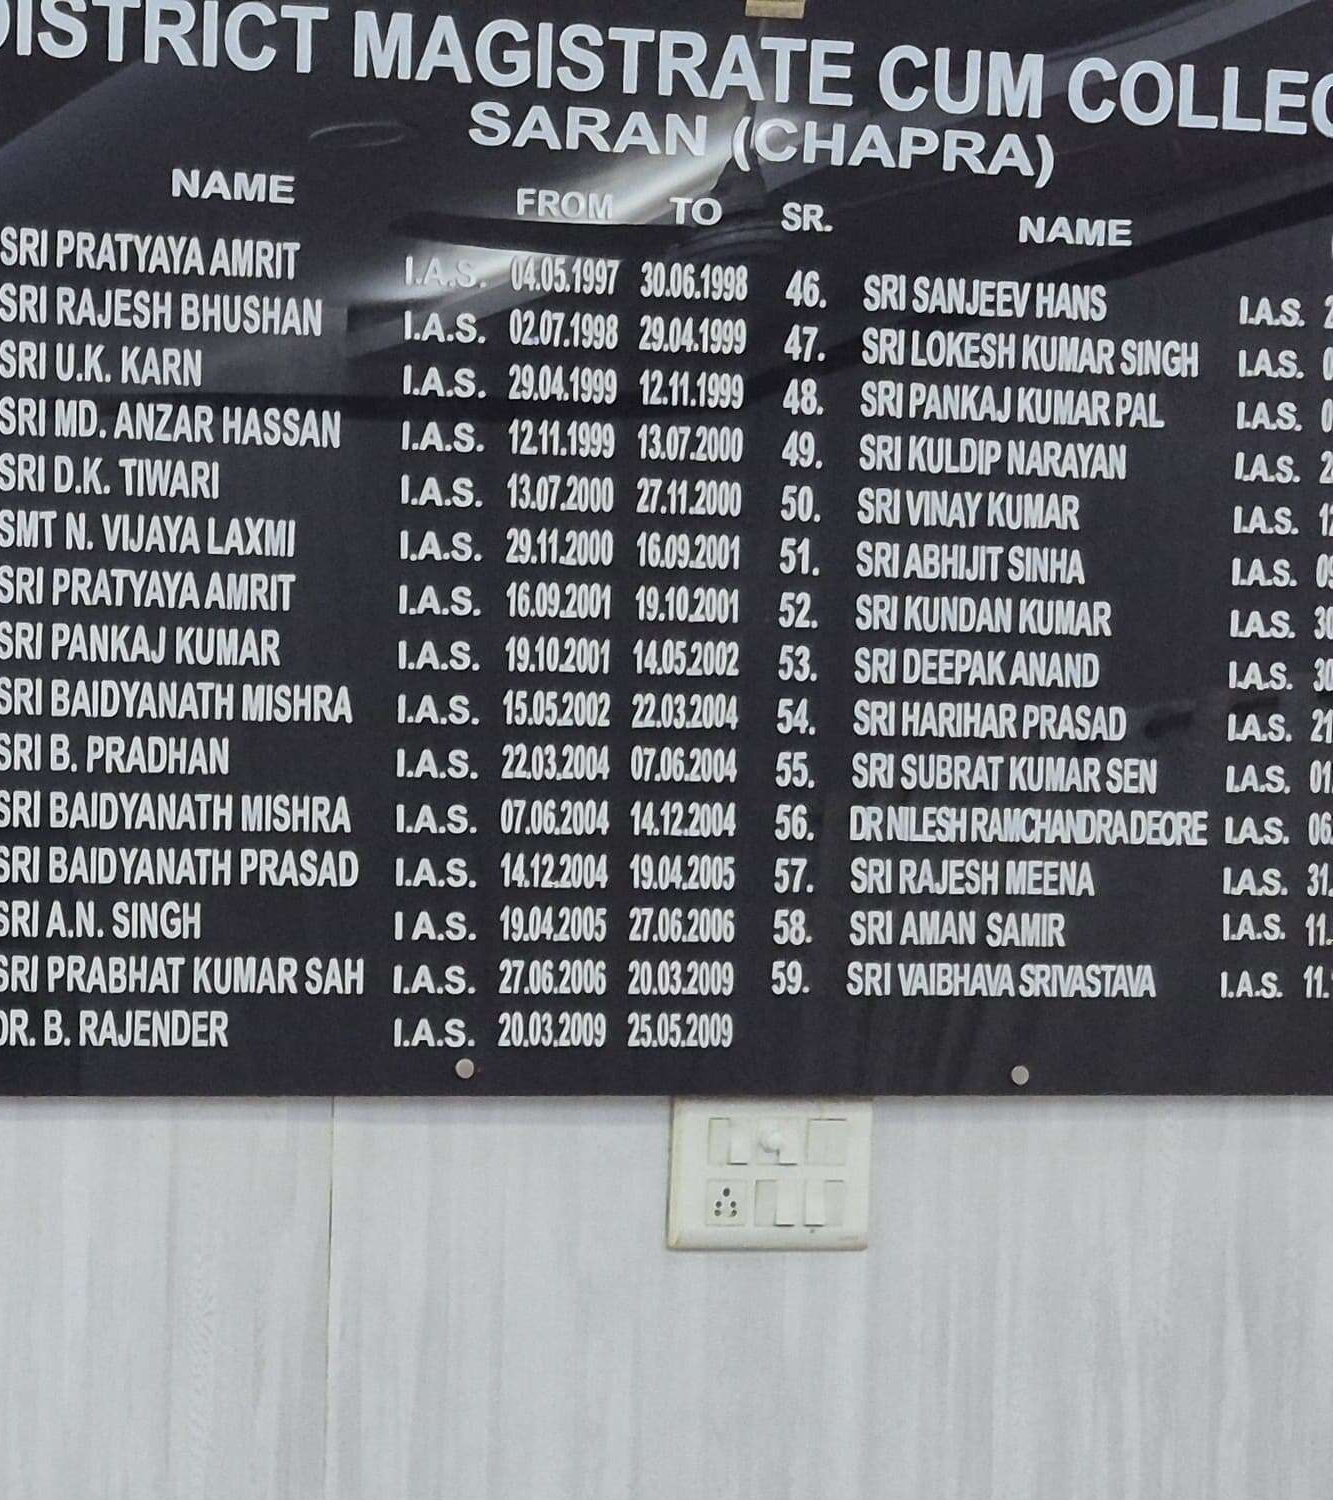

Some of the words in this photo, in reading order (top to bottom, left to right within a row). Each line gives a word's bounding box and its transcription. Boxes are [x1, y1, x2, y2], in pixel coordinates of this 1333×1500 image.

[353, 10, 854, 108] MAGISTRATE
[879, 45, 1044, 118] CUM
[468, 98, 708, 158] SARAN
[733, 113, 1055, 188] (CHAPRA)
[172, 168, 295, 204] NAME
[516, 187, 613, 218] FROM
[670, 197, 722, 225] TO
[781, 202, 833, 232] SR.
[1019, 216, 1132, 246] NAME
[0, 226, 48, 267] SRI
[57, 230, 204, 275] PRATYAYA
[210, 238, 301, 280] AMRIT
[510, 255, 620, 295] 04.05.1997
[641, 261, 748, 301] 30.06.1998
[0, 283, 46, 323] SRI
[57, 287, 171, 329] RAJESH
[181, 294, 322, 336] BHUSHAN
[404, 311, 486, 343] I.A.S.
[510, 309, 618, 349] 02.07.1998
[639, 315, 746, 354] 29.04.1999
[786, 270, 826, 308] 46.
[863, 274, 906, 311] SRI
[912, 276, 1031, 317] SANJEEV
[1036, 283, 1107, 321] HANS
[1239, 296, 1305, 327] I.A.S.
[0, 340, 46, 379] SRI
[56, 343, 111, 382] U.K.
[122, 346, 201, 386] KARN
[509, 364, 617, 404] 29.04.1999
[640, 369, 744, 409] 12.11.1999
[862, 327, 905, 365] SRI
[912, 330, 1015, 369] LOKESH
[1022, 335, 1114, 374] KUMAR
[1121, 339, 1198, 377] SINGH
[861, 381, 903, 418] SRI
[910, 383, 1011, 422] PANKAJ
[1018, 387, 1110, 425] KUMAR
[1116, 392, 1165, 428] PAL
[55, 399, 106, 438] MD.
[114, 402, 213, 443] ANZAR
[223, 407, 341, 448] HASSAN
[508, 419, 615, 458] 12.11.1999
[638, 424, 743, 462] 13.07.2000
[859, 434, 901, 471] SRI
[909, 436, 1001, 475] KULDIP
[1008, 440, 1126, 479] NARAYAN
[55, 456, 110, 494] D.K.
[119, 458, 219, 499] TIWARI
[507, 473, 614, 512] 13.07.2000
[636, 477, 741, 516] 27.11.2000
[857, 488, 900, 524] SRI
[906, 490, 982, 528] VINAY
[988, 491, 1079, 530] KUMAR
[66, 512, 93, 550] N.
[102, 514, 200, 554] VIJAYA
[208, 517, 295, 557] LAXMI
[506, 528, 613, 565] 29.11.2000
[637, 531, 740, 569] 16.09.2001
[856, 541, 899, 578] SRI
[904, 543, 1003, 581] ABHIJIT
[1008, 546, 1085, 584] SINHA
[53, 568, 200, 609] PRATYAYA
[205, 572, 296, 611] AMRIT
[507, 581, 611, 619] 16.09.2001
[636, 585, 738, 623] 19.10.2001
[856, 594, 898, 630] SRI
[905, 596, 1012, 633] KUNDAN
[1019, 599, 1111, 636] KUMAR
[52, 623, 166, 663] PANKAJ
[176, 627, 280, 666] KUMAR
[505, 636, 610, 674] 19.10.2001
[633, 639, 739, 676] 14.05.2002
[855, 647, 896, 683] SRI
[903, 649, 1005, 685] DEEPAK
[1010, 651, 1099, 688] ANAND
[52, 680, 233, 720] BAIDYANATH
[242, 684, 353, 723] MISHRA
[503, 689, 610, 726] 15.05.2002
[632, 693, 739, 730] 22.03.2004
[853, 699, 895, 736] SRI
[902, 702, 1016, 738] HARIHAR
[1023, 705, 1126, 740] PRASAD
[51, 734, 77, 772] B.
[87, 735, 229, 774] PRADHAN
[501, 743, 610, 780] 22.03.2004
[631, 745, 737, 783] 07.06.2004
[852, 753, 894, 788] SRI
[901, 754, 1004, 791] SUBRAT
[1010, 756, 1101, 792] KUMAR
[1106, 758, 1157, 794] SEN
[50, 792, 232, 831] BAIDYANATH
[242, 794, 351, 833] MISHRA
[501, 798, 609, 835] 07.06.2004
[631, 801, 736, 837] 14.12.2004
[49, 847, 231, 885] BAIDYANATH
[241, 849, 359, 887] PRASAD
[501, 852, 608, 888] 14.12.2004
[630, 854, 735, 890] 19.04.2005
[851, 857, 891, 893] SRI
[900, 859, 998, 895] RAJESH
[1006, 861, 1095, 896] MEENA
[46, 901, 103, 938] A.N.
[113, 901, 201, 939] SINGH
[500, 905, 607, 942] 19.04.2005
[629, 907, 735, 942] 27.06.2006
[850, 911, 892, 945] SRI
[900, 911, 975, 945] AMAN
[986, 912, 1065, 947] SAMIR
[48, 955, 185, 993] PRABHAT
[194, 957, 297, 994] KUMAR
[305, 957, 364, 994] SAH
[499, 959, 606, 995] 27.06.2006
[628, 960, 734, 995] 20.03.2009
[772, 961, 810, 994] 59.
[847, 961, 891, 996] SRI
[898, 963, 1015, 997] VAIBHAVA
[1019, 964, 1156, 997] SRIVASTAVA
[1221, 971, 1283, 998] I.A.S.
[44, 1010, 70, 1046] B.
[79, 1010, 228, 1047] RAJENDER
[394, 1018, 475, 1047] I.A.S.
[498, 1011, 606, 1047] 20.03.2009
[628, 1012, 733, 1048] 25.05.2009
